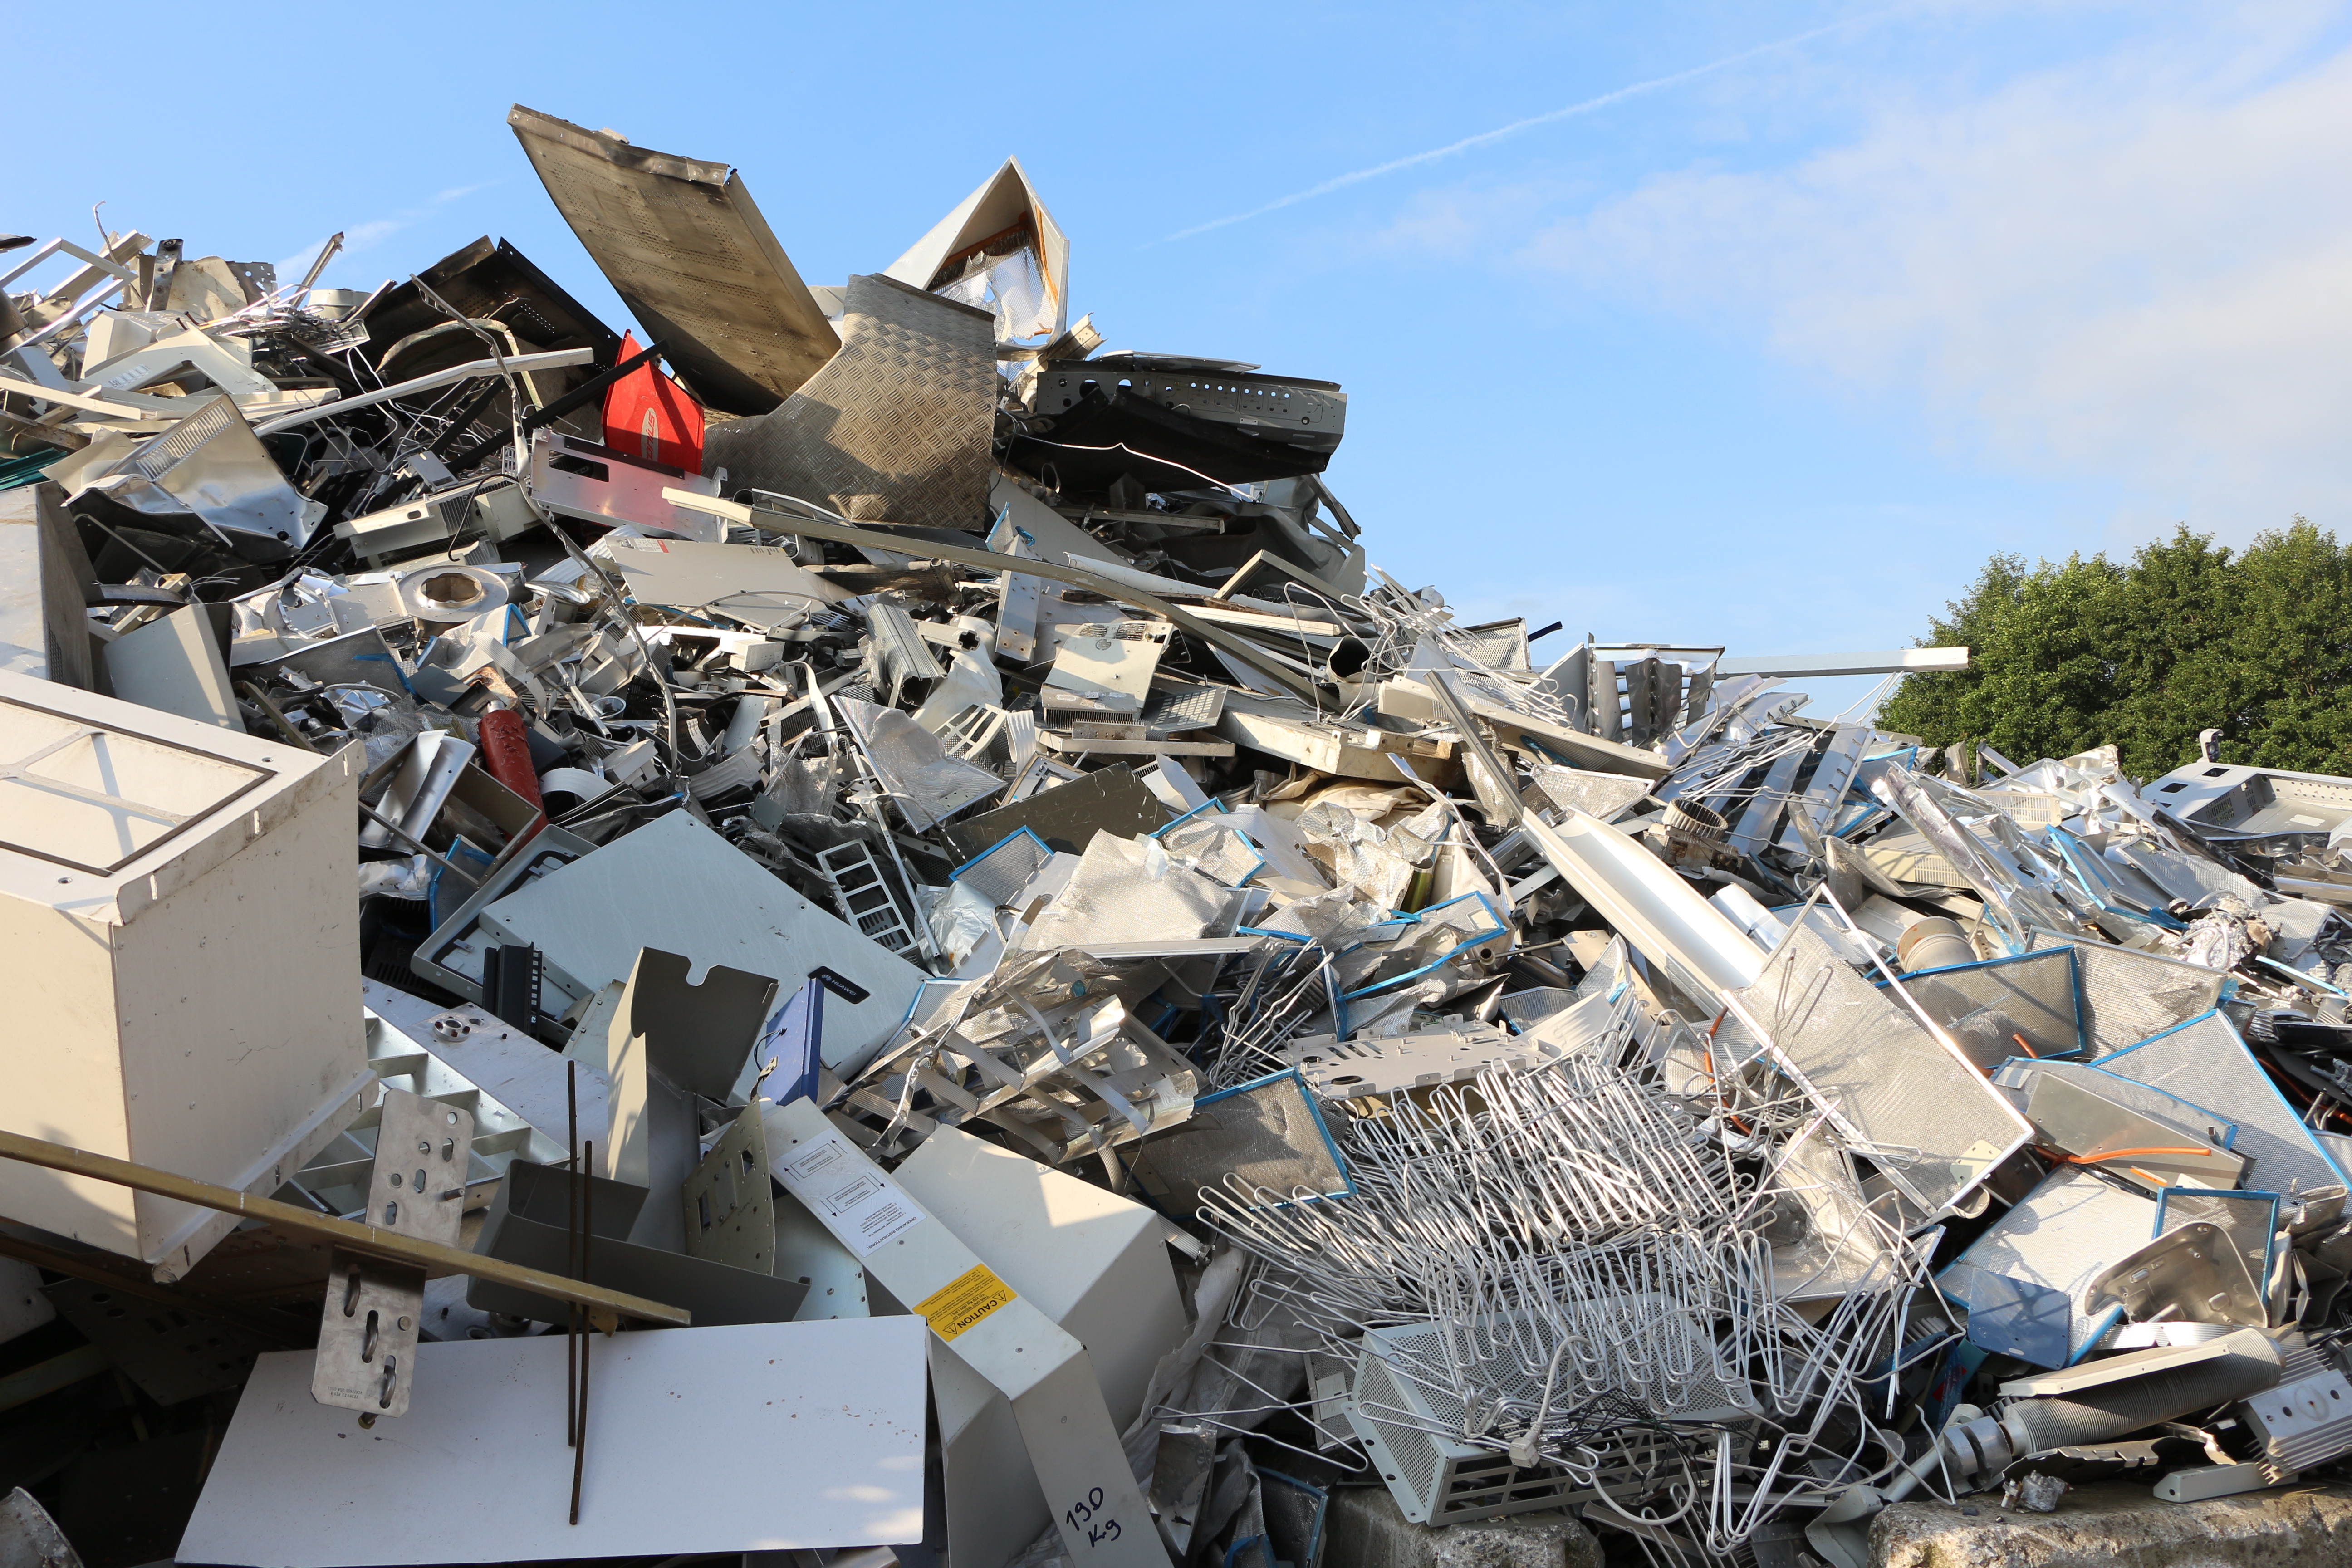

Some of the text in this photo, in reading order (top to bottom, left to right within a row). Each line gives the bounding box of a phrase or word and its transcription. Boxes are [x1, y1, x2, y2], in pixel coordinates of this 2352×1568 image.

[831, 980, 857, 996] HUAWEI
[737, 1197, 753, 1216] OUTPUT
[867, 1216, 917, 1249] OPERATING INSTRUCTIONS:
[957, 1306, 972, 1316] WEIGHS
[957, 1299, 998, 1328] CAUTION
[1066, 1487, 1103, 1531] 190
[1088, 1519, 1121, 1548] Kg
